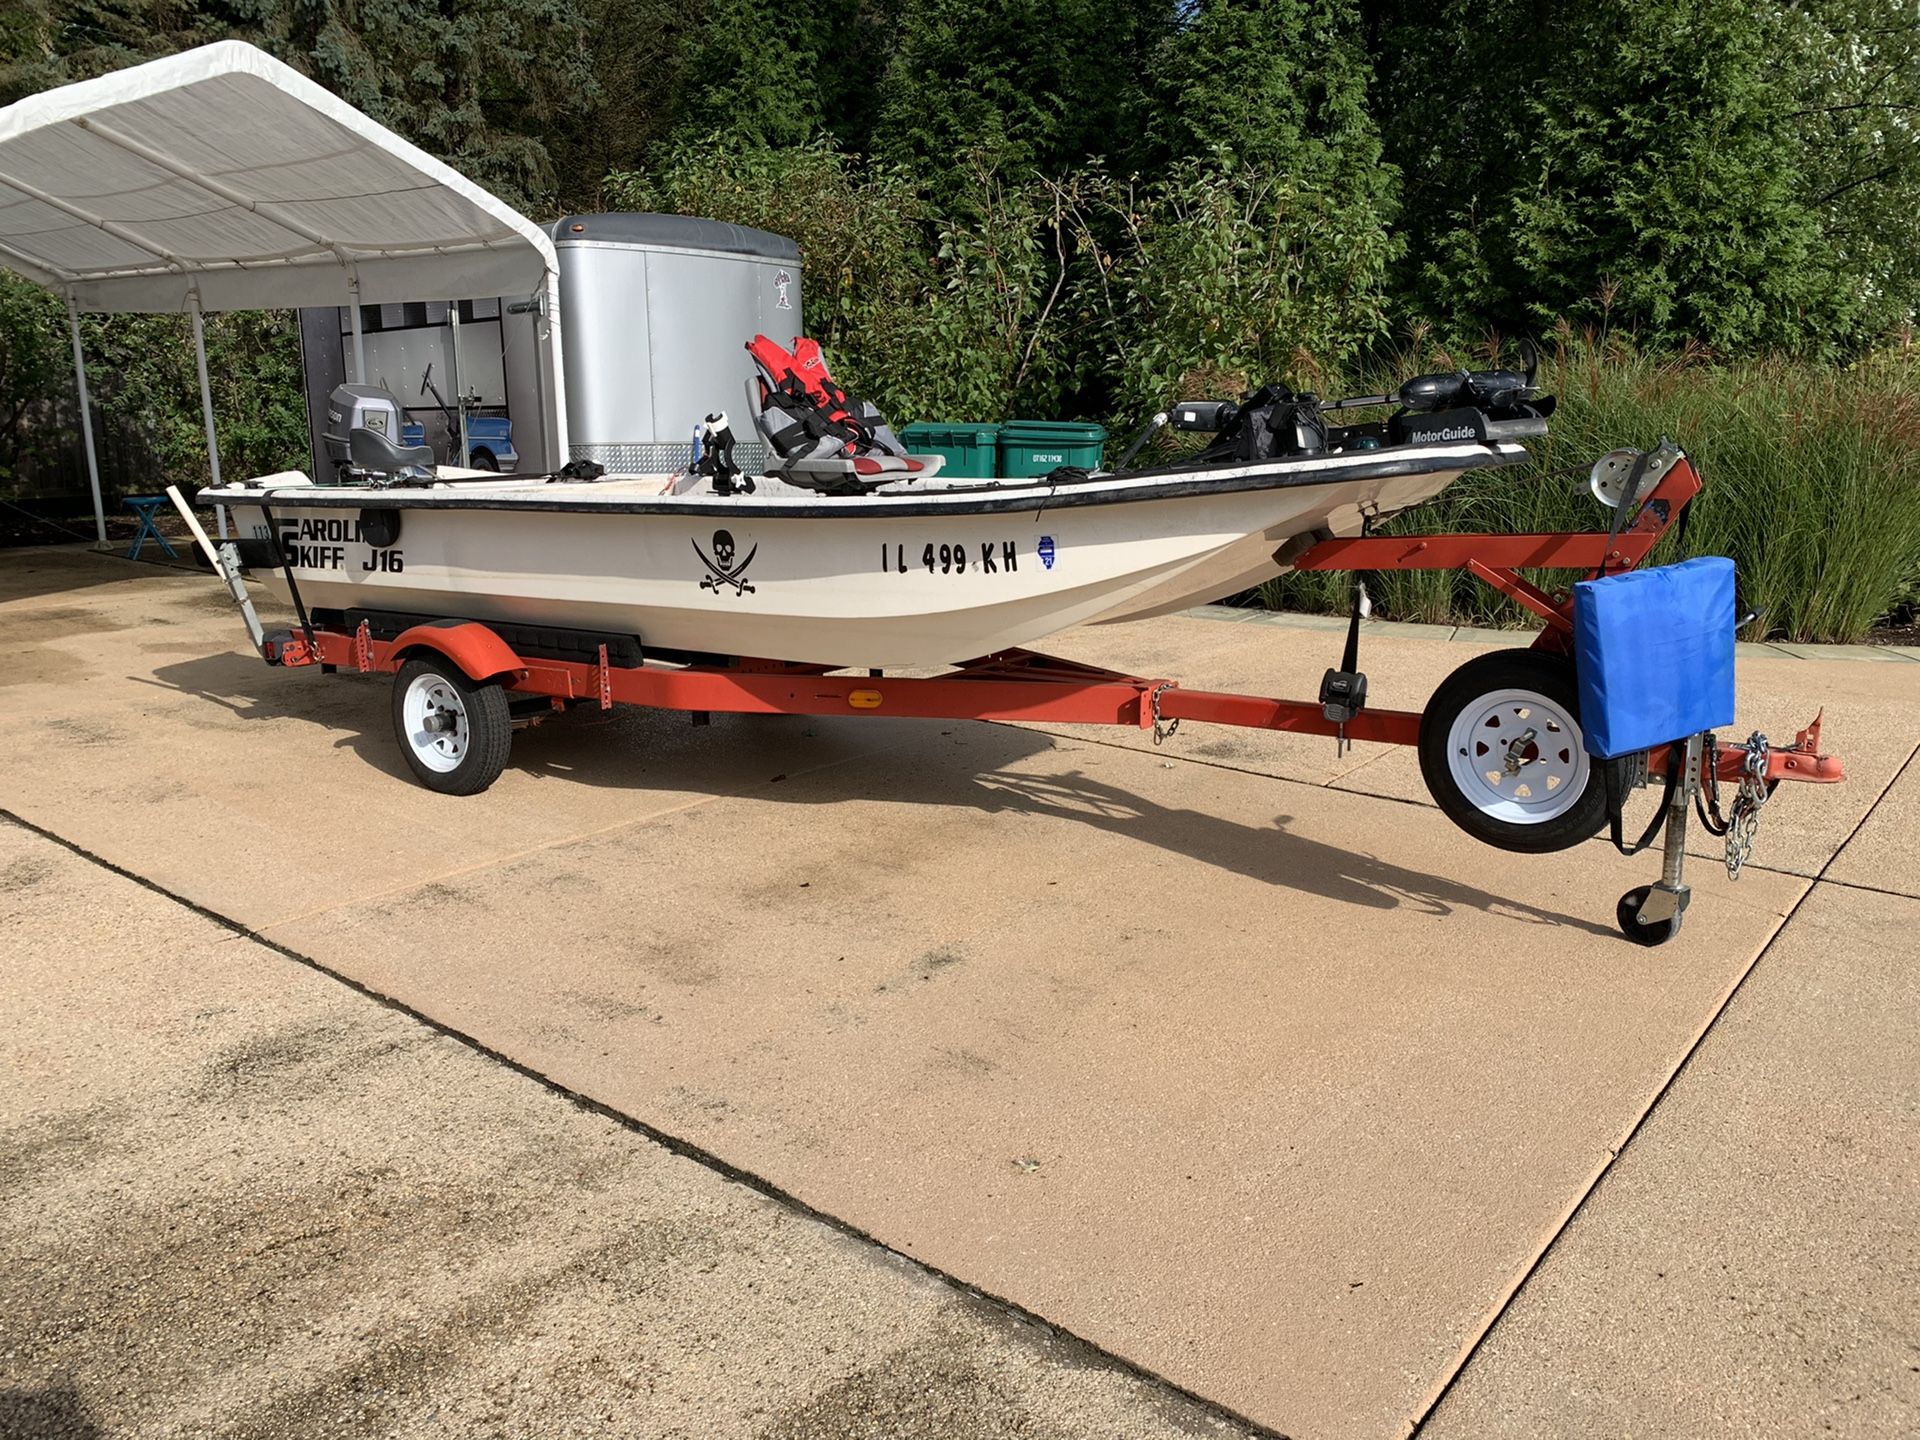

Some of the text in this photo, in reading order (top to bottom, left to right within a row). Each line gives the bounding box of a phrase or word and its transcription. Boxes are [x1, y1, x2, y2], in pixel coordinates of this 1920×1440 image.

[1412, 426, 1476, 443] MotorGuide
[281, 532, 404, 573] SKIFF J16
[922, 543, 966, 574] 499
[981, 541, 1018, 573] KH
